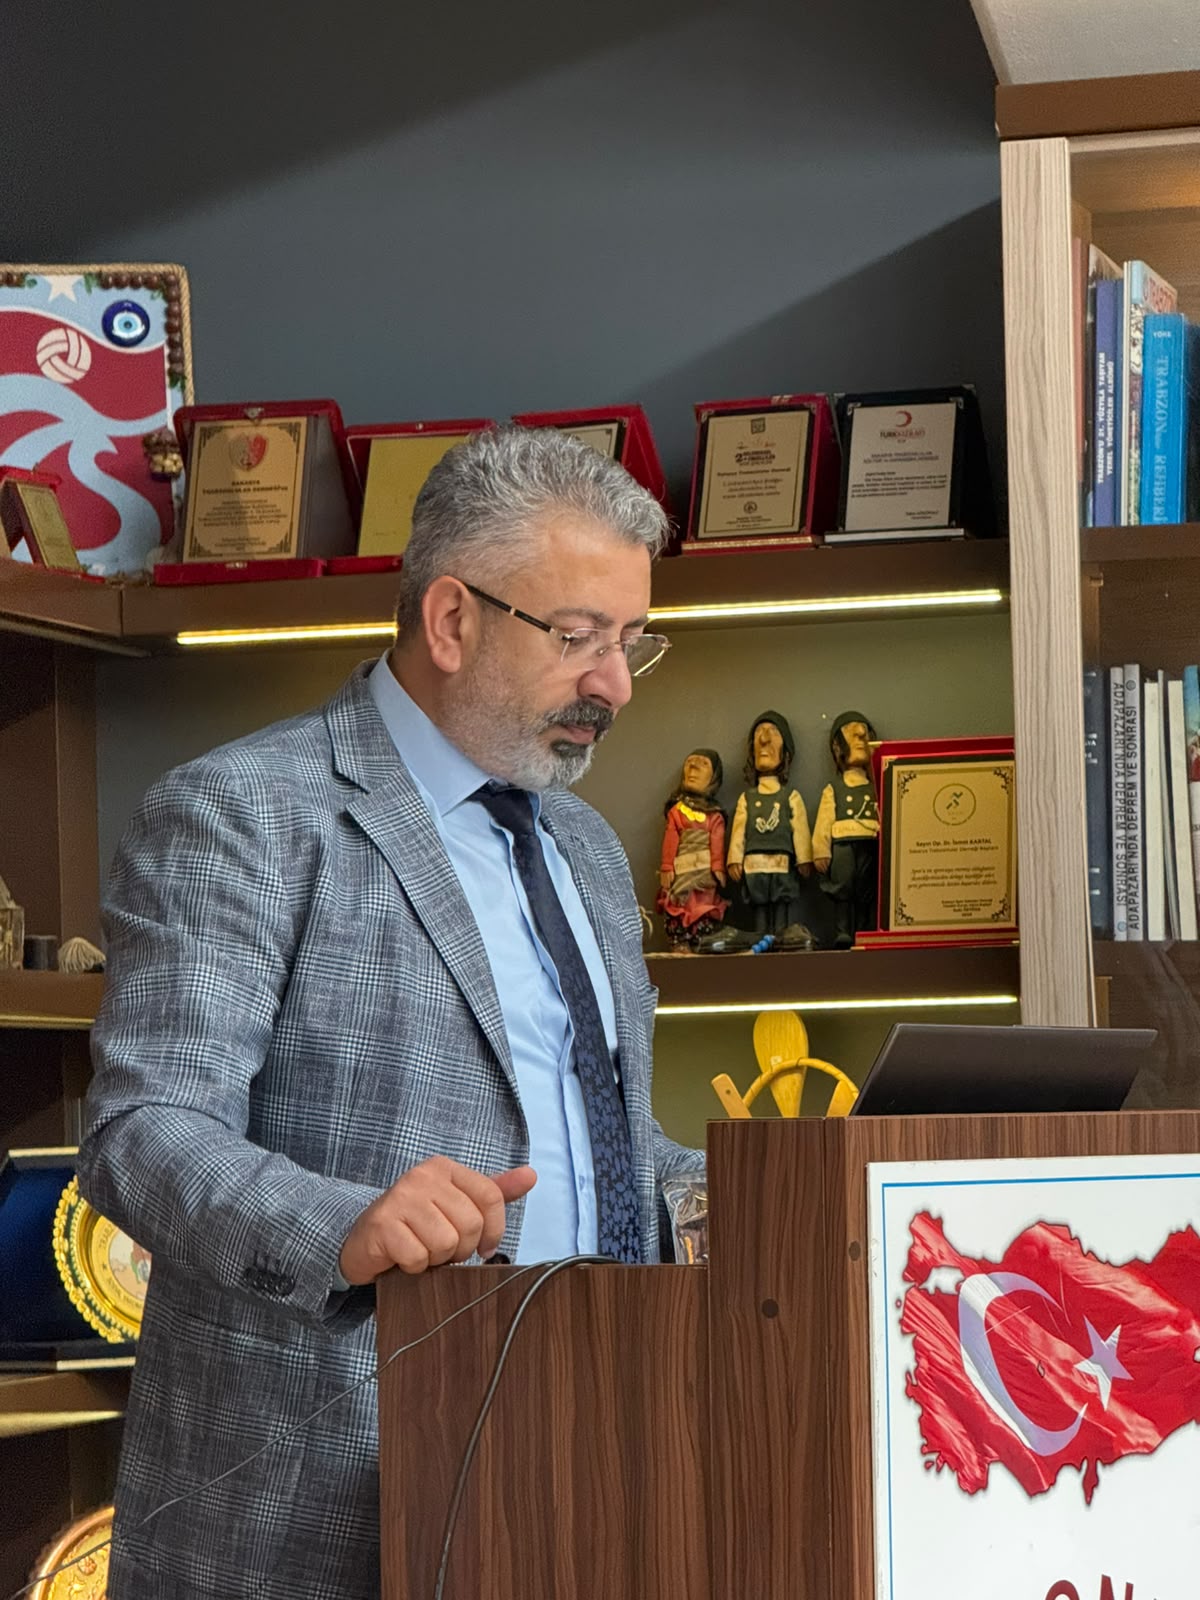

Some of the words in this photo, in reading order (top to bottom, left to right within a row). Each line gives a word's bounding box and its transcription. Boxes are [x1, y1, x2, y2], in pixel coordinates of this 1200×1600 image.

[1154, 354, 1169, 433] TRABZON
[1152, 455, 1168, 522] REHBERİ
[1113, 682, 1126, 778] ADAPAZARI'NDA
[1125, 705, 1137, 760] SONRASI
[1126, 764, 1137, 778] VE
[1115, 781, 1127, 831] DEPREM
[1126, 781, 1138, 830] DEPREM
[1115, 836, 1128, 850] VE
[1115, 854, 1128, 907] SONRASI
[1126, 834, 1139, 930] ADAPAZARI'NDA
